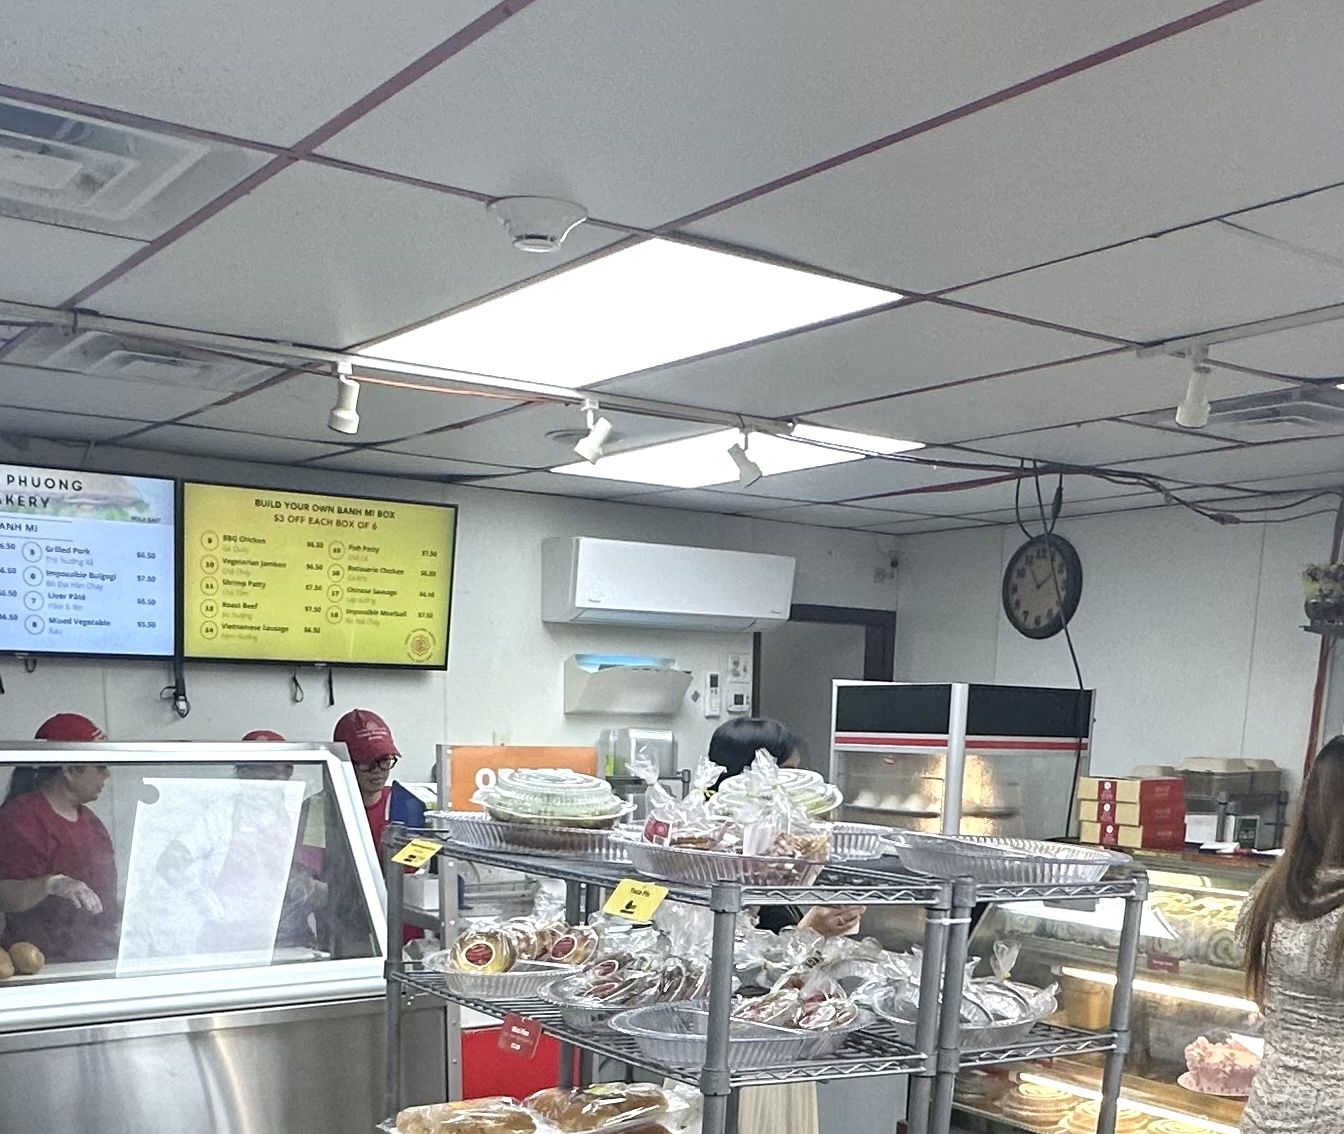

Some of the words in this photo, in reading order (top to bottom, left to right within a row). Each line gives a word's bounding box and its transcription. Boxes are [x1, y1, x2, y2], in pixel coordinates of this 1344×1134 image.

[6, 474, 83, 491] PHUONG
[255, 499, 282, 509] BUILD
[284, 501, 310, 512] YOUR
[312, 504, 335, 514] OWN
[337, 506, 362, 516] BANH
[377, 509, 396, 519] BOX
[287, 515, 305, 524] OFF
[308, 517, 333, 527] EACH
[336, 519, 355, 528] BOX
[357, 521, 370, 530] OF
